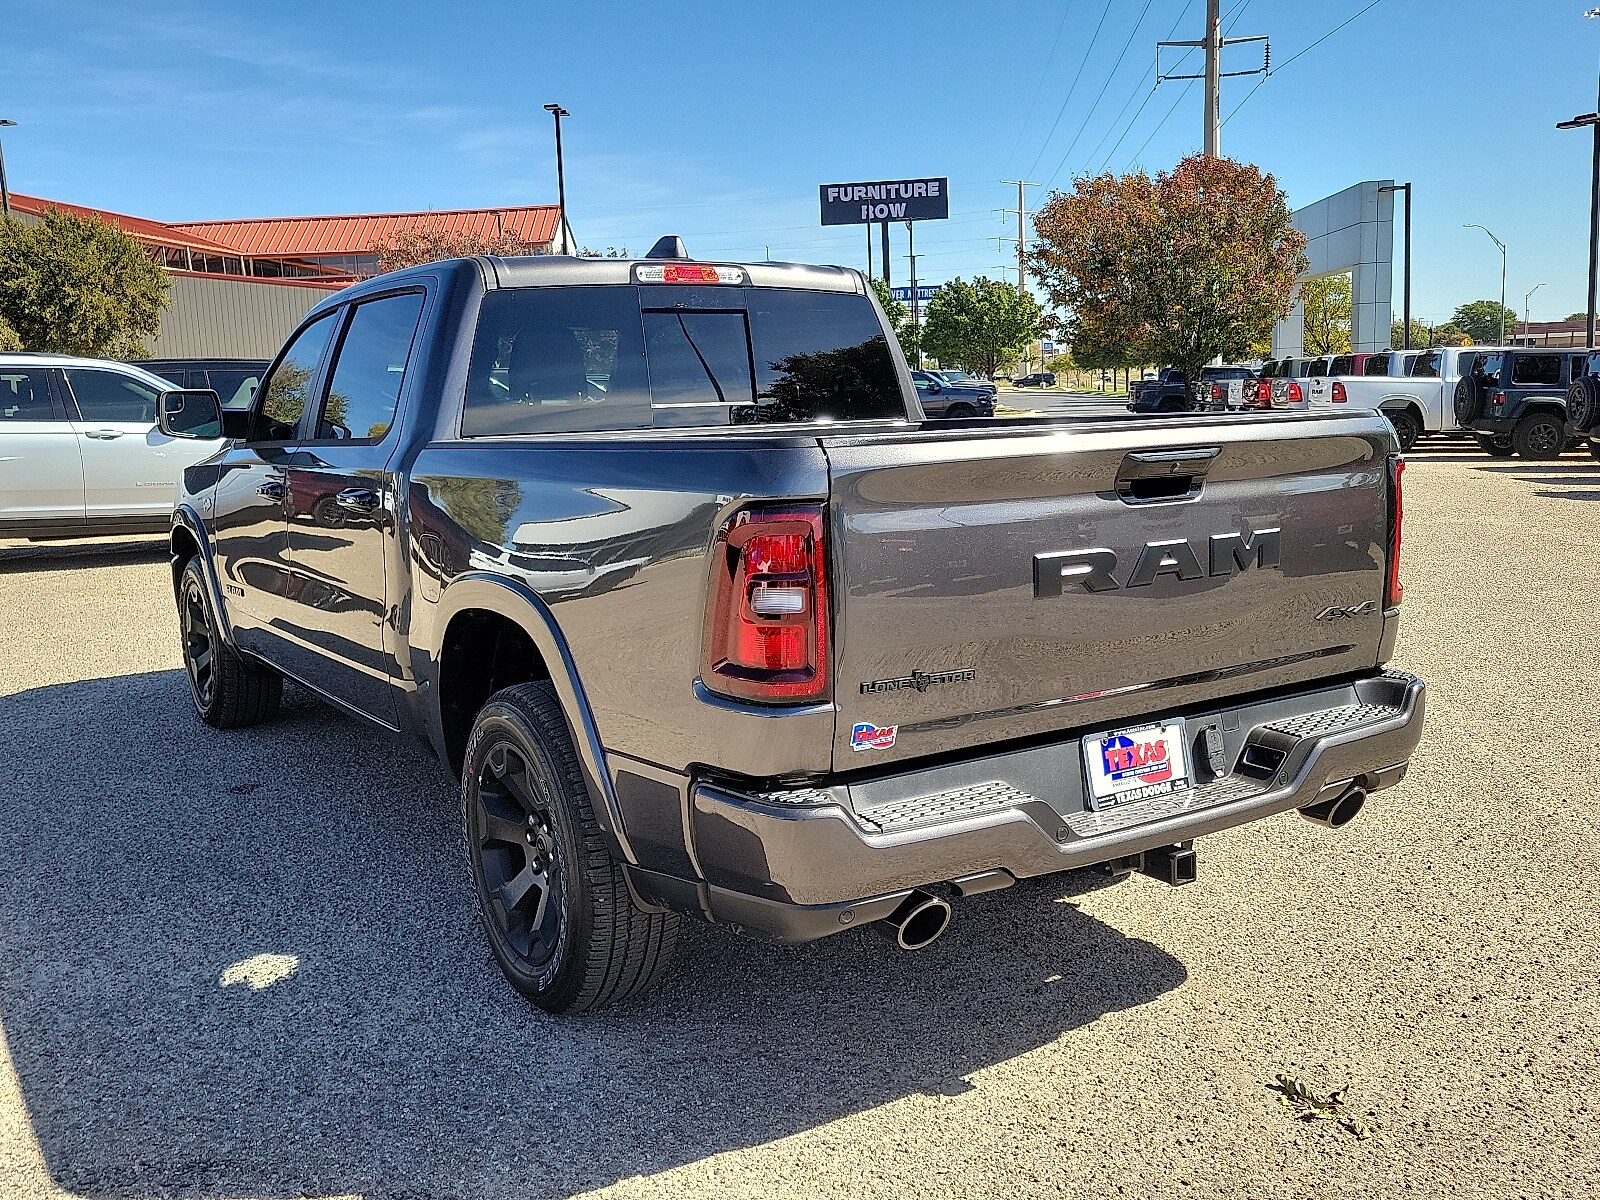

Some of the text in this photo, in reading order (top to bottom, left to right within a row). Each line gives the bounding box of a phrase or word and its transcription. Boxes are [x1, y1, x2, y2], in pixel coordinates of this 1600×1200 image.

[828, 181, 940, 202] FURNITURE
[861, 202, 907, 220] ROW
[1033, 527, 1281, 599] RAM
[860, 668, 976, 695] LONE STAR
[855, 726, 895, 742] TEXAS
[1104, 739, 1167, 772] TEXAS
[1114, 788, 1142, 804] TEXAS
[1142, 781, 1172, 798] DODGE
